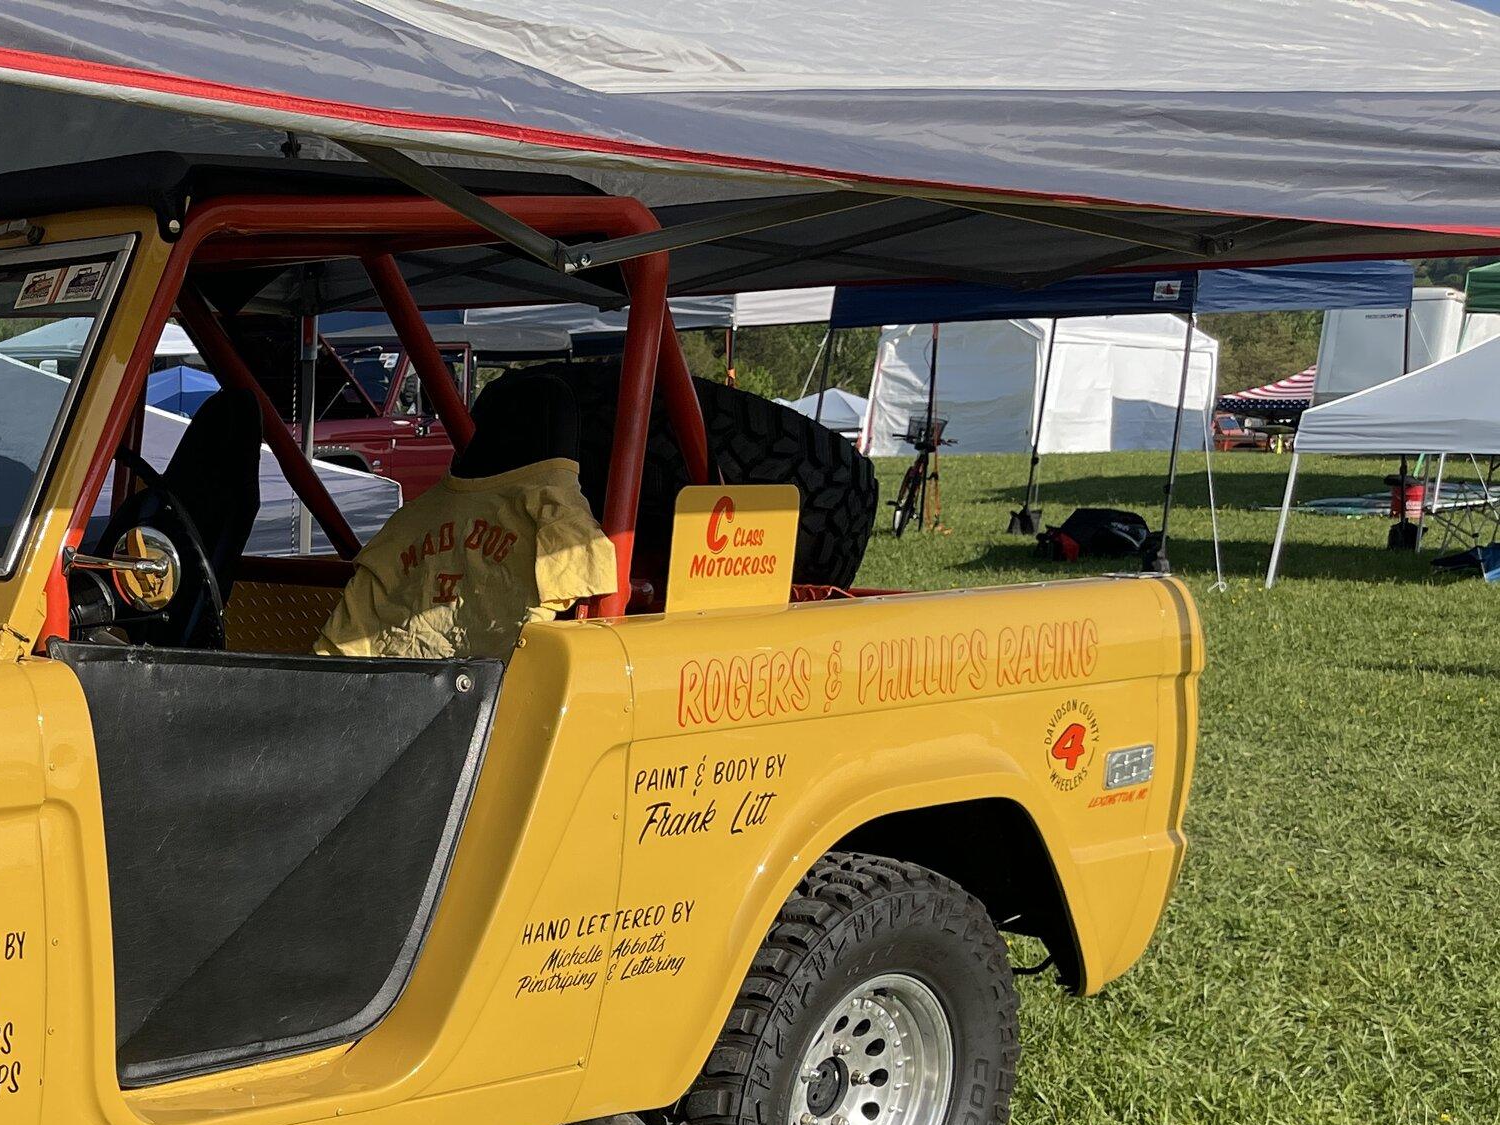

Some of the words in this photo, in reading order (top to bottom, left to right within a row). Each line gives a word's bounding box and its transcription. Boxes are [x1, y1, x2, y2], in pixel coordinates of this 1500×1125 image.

[400, 521, 455, 576] MAD
[463, 518, 518, 564] DOG
[706, 496, 735, 554] C
[733, 527, 764, 547] CLASS
[690, 555, 776, 578] MOTOCROSS
[678, 647, 812, 728] ROGERS
[823, 640, 842, 713] &
[857, 629, 988, 705] PHILLIPS
[996, 617, 1099, 688] RACING
[1044, 699, 1078, 745] DAVIDSON
[1078, 701, 1100, 743] COUNTY
[1051, 723, 1086, 771] 4
[635, 765, 688, 794] PAINT
[693, 754, 707, 797] &
[713, 757, 759, 786] BODY
[765, 753, 787, 779] BY
[1049, 766, 1088, 792] WHEELERS
[638, 800, 716, 845] Frank
[522, 918, 569, 945] HAND
[577, 905, 665, 938] LETTERED
[672, 900, 695, 923] BY
[4, 931, 26, 960] BY
[540, 941, 603, 974] Michelle
[515, 969, 597, 998] Pinstriping
[605, 963, 616, 986] &
[620, 954, 686, 981] Lettering
